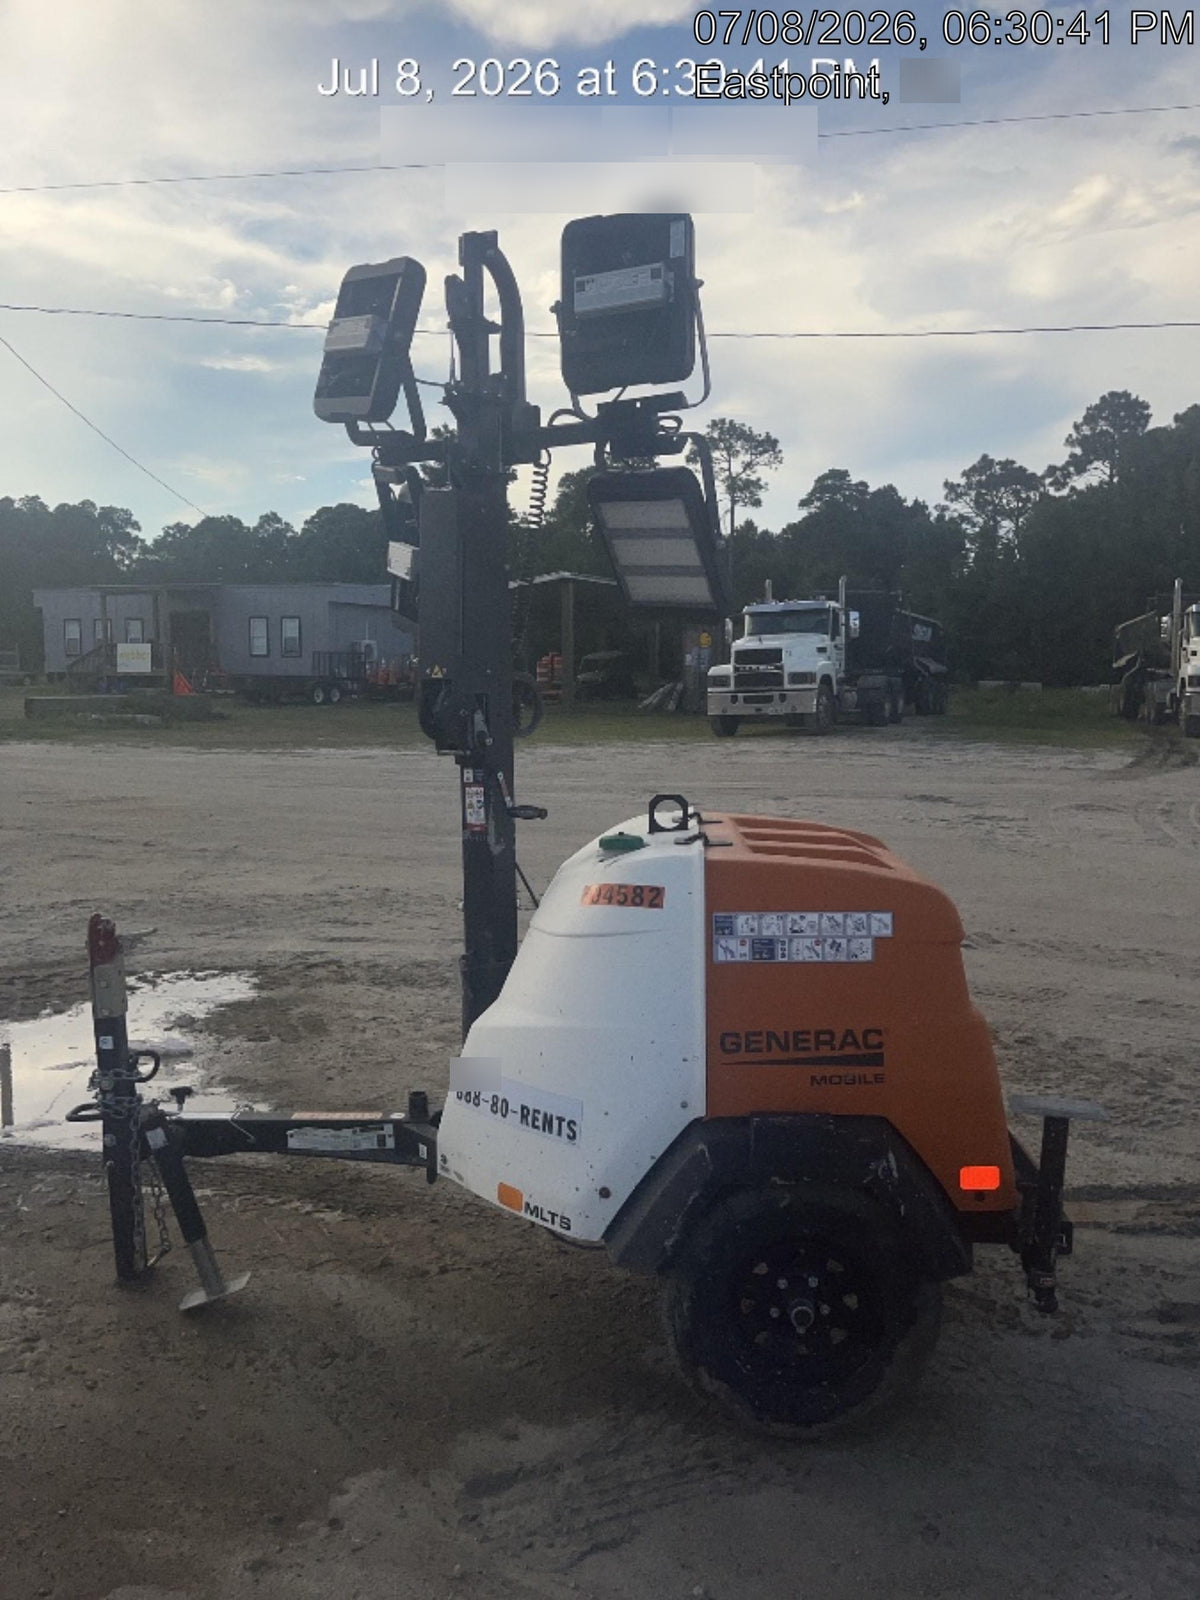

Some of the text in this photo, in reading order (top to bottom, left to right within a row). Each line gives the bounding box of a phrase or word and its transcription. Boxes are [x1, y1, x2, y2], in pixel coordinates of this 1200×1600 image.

[719, 1028, 885, 1054] GENERAC
[810, 1072, 886, 1086] MOBILE
[524, 1201, 572, 1231] MLTS
